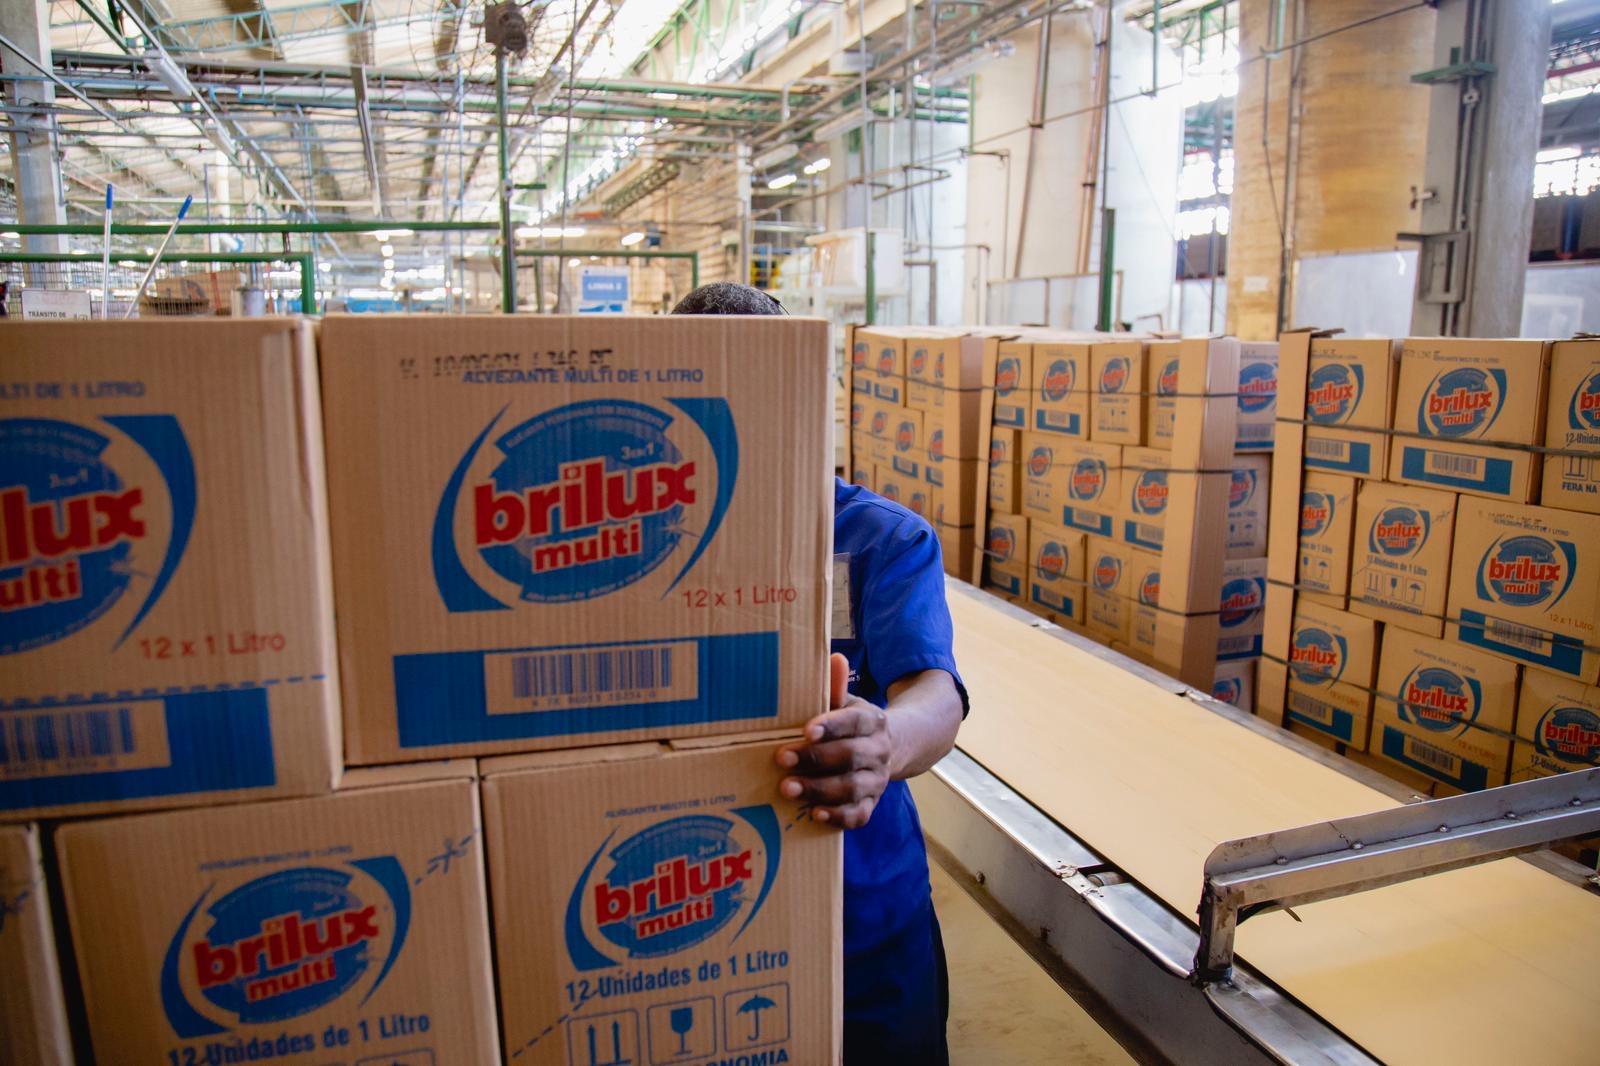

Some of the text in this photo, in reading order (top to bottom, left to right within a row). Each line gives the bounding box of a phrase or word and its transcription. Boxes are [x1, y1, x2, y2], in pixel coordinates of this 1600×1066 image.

[36, 383, 62, 399] DE
[86, 381, 145, 399] LITRO
[462, 368, 704, 384] ALVEJANTE MULTI DE 1 LITRO
[1430, 388, 1493, 414] brilux
[1442, 412, 1474, 426] multi
[474, 461, 696, 546] brilux
[0, 487, 146, 562] lux
[1377, 522, 1421, 539] brilux
[534, 523, 642, 573] multi
[1489, 556, 1561, 581] brilux
[0, 559, 82, 610] ulti
[683, 585, 798, 608] 12 x 1 Litro
[1503, 582, 1540, 595] multi
[139, 633, 286, 660] 12 x 1 Litro
[1407, 682, 1469, 713] brilux
[594, 850, 752, 925] brilux
[637, 896, 713, 939] multi
[194, 905, 379, 987] brilux
[248, 956, 337, 1001] multi
[698, 959, 720, 982] de
[728, 955, 737, 976] 1
[746, 950, 789, 974] Litro
[323, 1025, 349, 1048] de
[358, 1020, 369, 1042] 1
[379, 1014, 431, 1040] Litro
